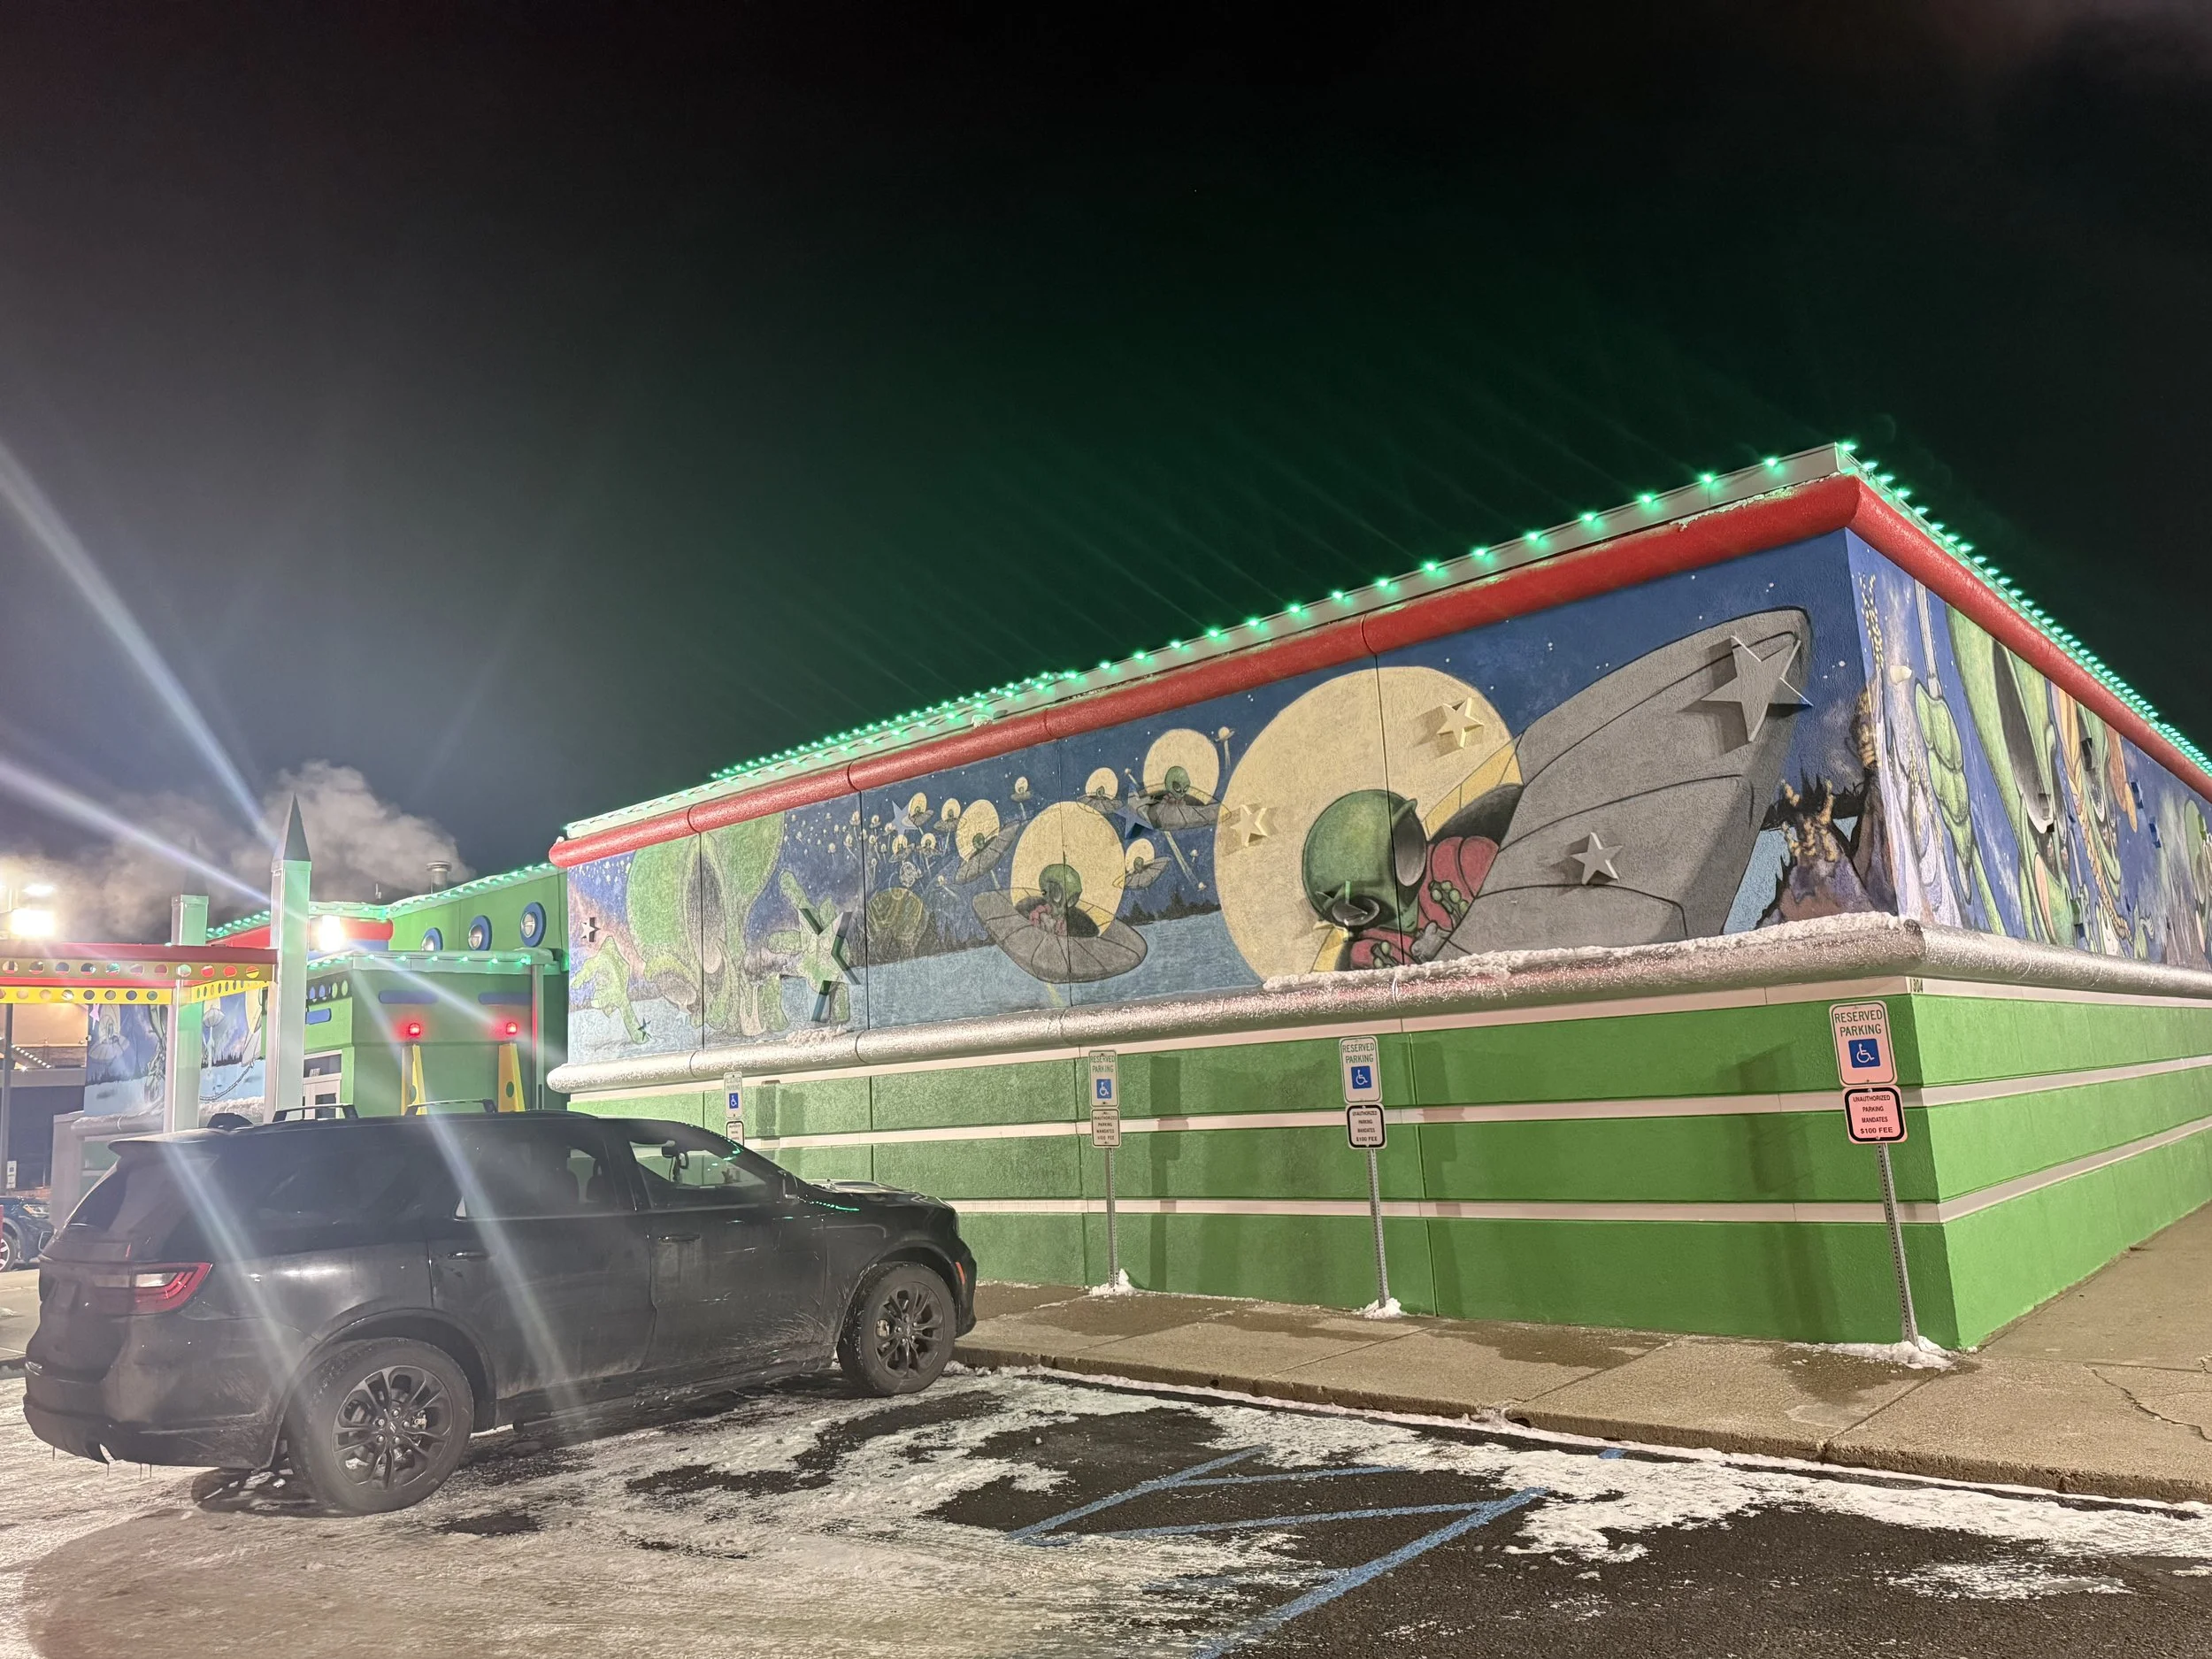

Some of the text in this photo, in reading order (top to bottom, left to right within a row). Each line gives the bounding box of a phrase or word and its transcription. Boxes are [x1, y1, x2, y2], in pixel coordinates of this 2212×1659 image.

[1909, 979, 1924, 993] 1304
[1834, 1010, 1883, 1023] RESERVED
[1840, 1024, 1882, 1037] PARKING
[1341, 1042, 1375, 1053] RESERVED
[1345, 1054, 1374, 1064] PARKING
